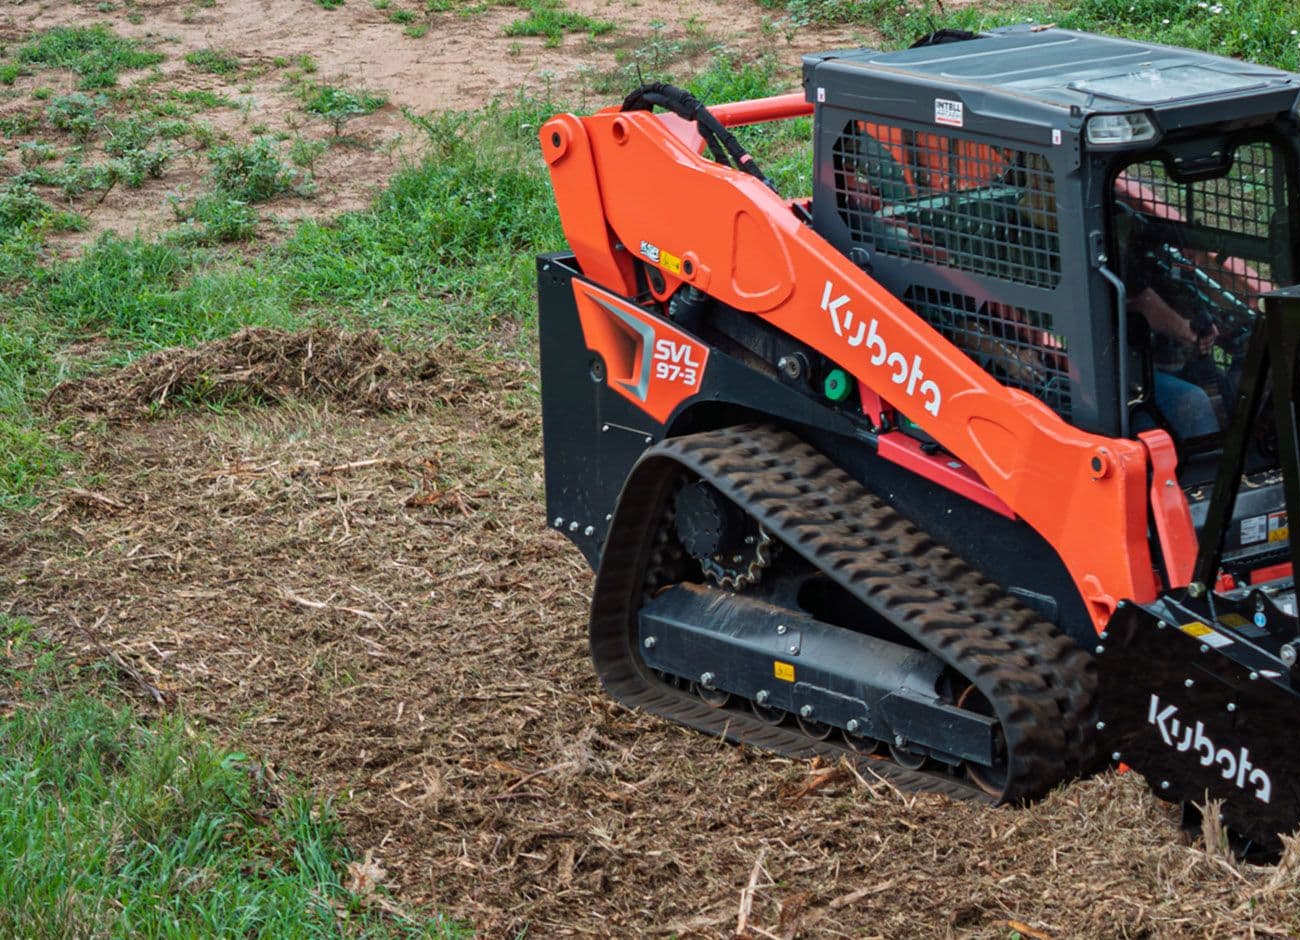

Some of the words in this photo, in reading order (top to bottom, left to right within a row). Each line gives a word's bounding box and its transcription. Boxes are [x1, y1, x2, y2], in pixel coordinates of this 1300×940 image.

[653, 339, 699, 368] SVL
[655, 362, 696, 386] 97-3
[820, 280, 942, 417] Kubota
[1147, 693, 1272, 804] Kubota
